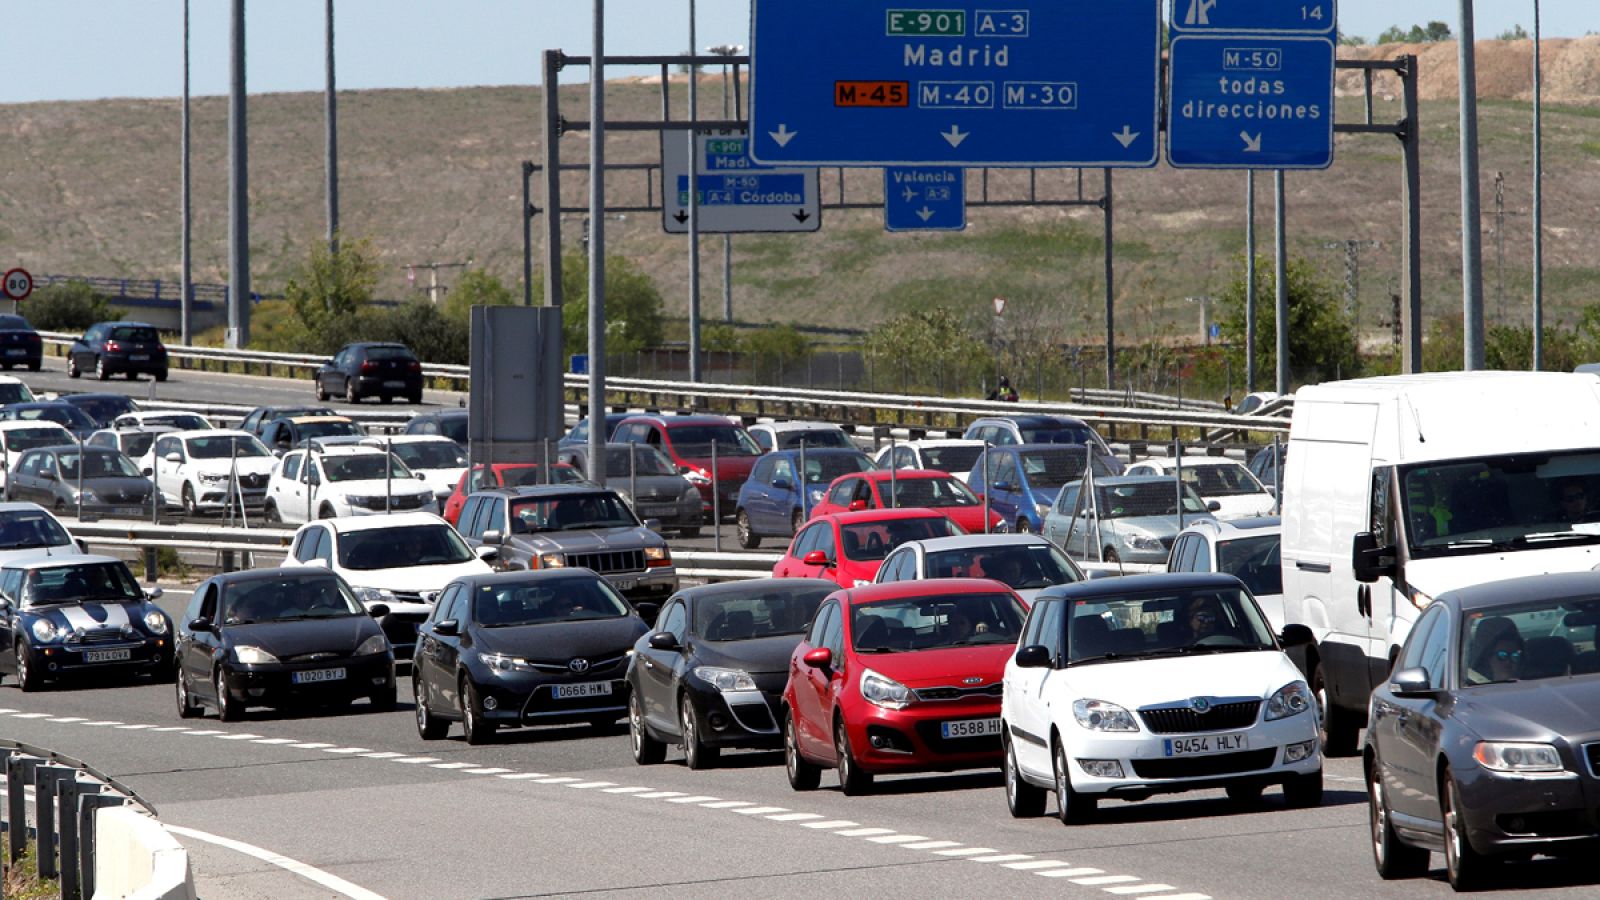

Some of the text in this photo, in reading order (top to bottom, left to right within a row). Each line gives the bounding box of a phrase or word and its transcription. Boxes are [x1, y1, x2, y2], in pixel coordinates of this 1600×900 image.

[1301, 5, 1323, 21] 14
[890, 12, 1025, 33] E-901 A-3
[904, 44, 1009, 67] Madrid
[1225, 52, 1278, 67] M-50
[1219, 76, 1285, 95] todas
[838, 85, 1074, 105] M-45 M-40 M-30
[1182, 100, 1321, 119] direcciones
[893, 170, 956, 183] Valencia
[710, 192, 731, 202] A-4
[740, 191, 801, 203] Córdoba
[9, 279, 27, 290] 80
[299, 669, 345, 682] 1020 BYJ
[559, 685, 586, 697] 0666
[951, 721, 985, 736] 3588
[1174, 735, 1242, 754] 9454 HLY
